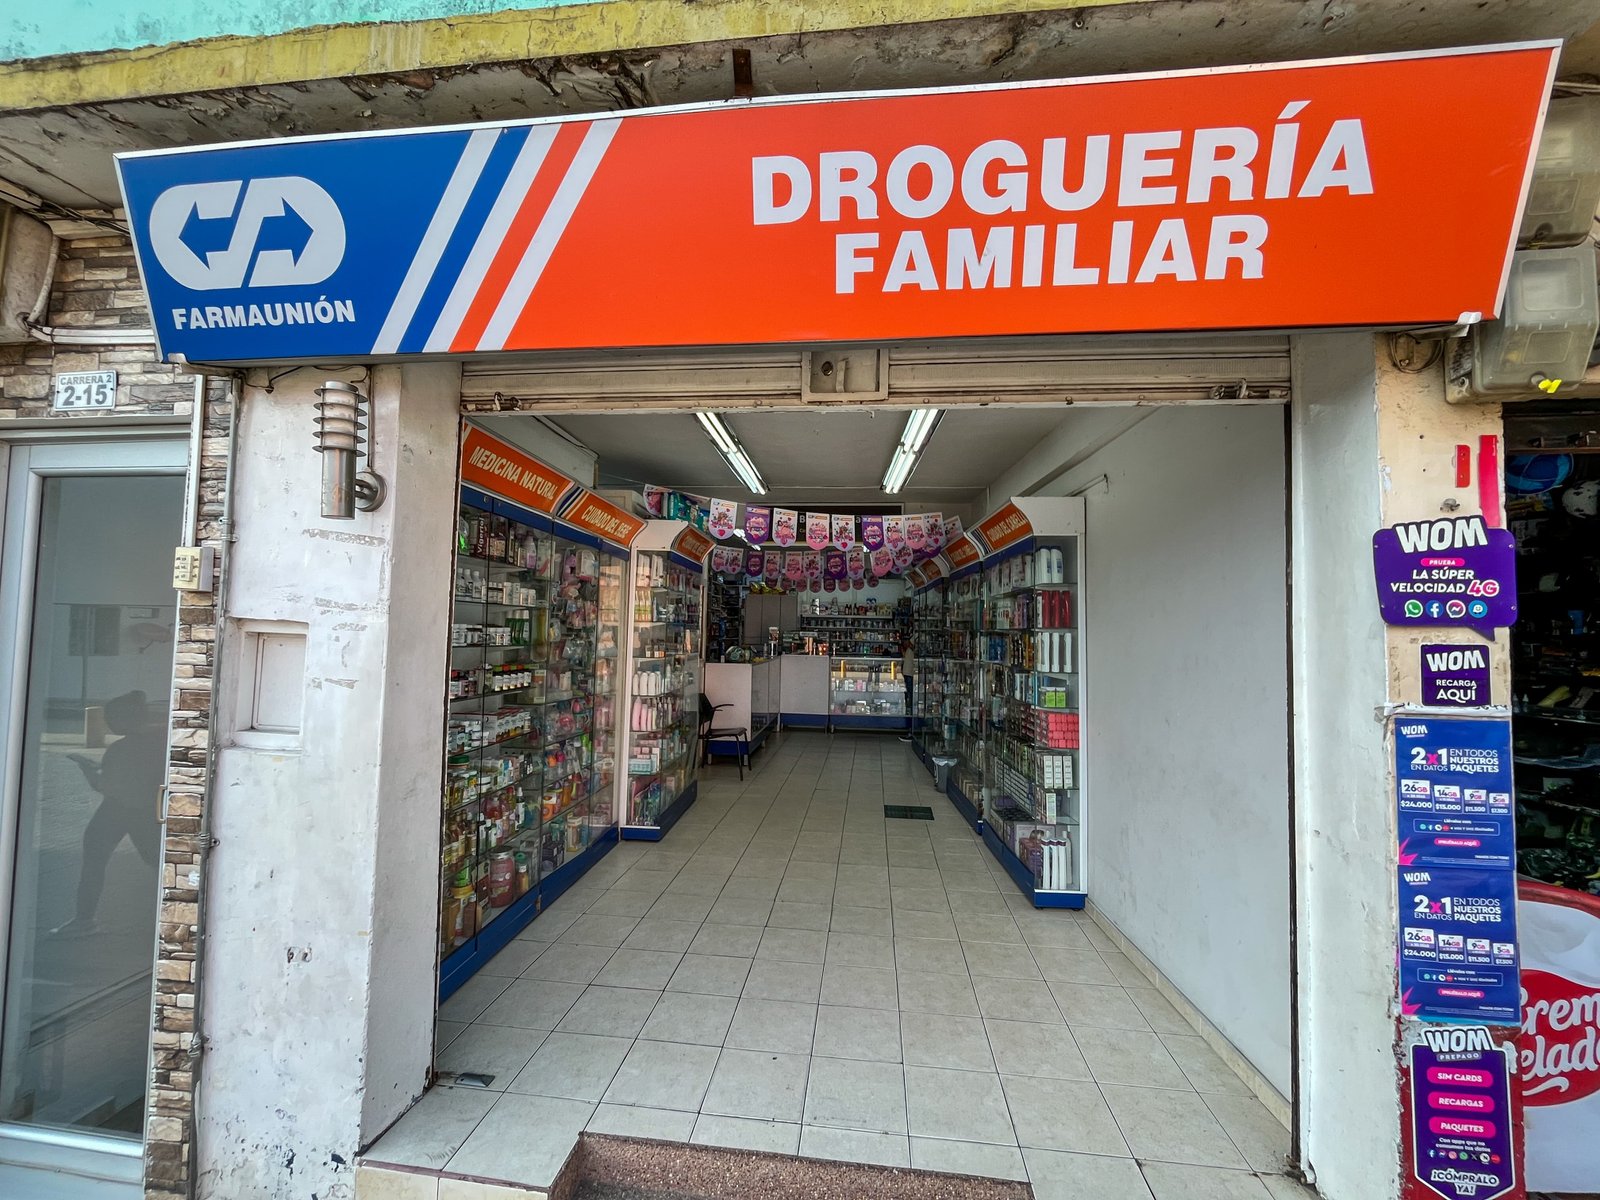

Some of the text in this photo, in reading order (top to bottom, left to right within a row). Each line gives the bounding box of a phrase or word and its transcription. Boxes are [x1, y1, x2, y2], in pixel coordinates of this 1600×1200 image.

[752, 101, 1374, 226] DROGUERÍA
[836, 214, 1270, 295] FAMILIAR
[172, 295, 356, 330] FARMAUNIÓN
[60, 374, 112, 385] CARRERA 2
[63, 384, 107, 406] 2-15
[468, 446, 558, 500] MEDICINA NATURAL
[581, 504, 611, 529] CUIDADO
[604, 517, 620, 534] DEL
[1396, 518, 1488, 553] WOM
[1412, 566, 1474, 579] LA SÚPER
[1390, 580, 1499, 597] VELOCIDAD 4G
[1426, 650, 1485, 671] WOM
[1436, 686, 1477, 703] AQUÍ
[1401, 725, 1428, 735] WOM
[1411, 747, 1448, 765] 2x1
[1464, 749, 1498, 757] TODOS
[1450, 757, 1499, 765] NUESTROS
[1450, 764, 1499, 774] PAQUETES
[1404, 784, 1428, 793] 26GB
[1400, 800, 1432, 808] $24.000
[1403, 872, 1431, 882] WOM
[1414, 895, 1452, 914] 2x1
[1467, 898, 1500, 906] TODOS
[1454, 906, 1501, 914] NUESTROS
[1454, 914, 1501, 923] PAQUETES
[1407, 932, 1432, 942] 26GB
[1404, 949, 1436, 958] $24.000
[1426, 1030, 1491, 1052] WOM
[1454, 1074, 1482, 1082] CARDS
[1438, 1097, 1483, 1107] RECARGAS
[1440, 1122, 1484, 1133] PAQUETES
[1433, 1170, 1497, 1185] ¡CÓMPRALO
[1457, 1185, 1474, 1194] YA!
